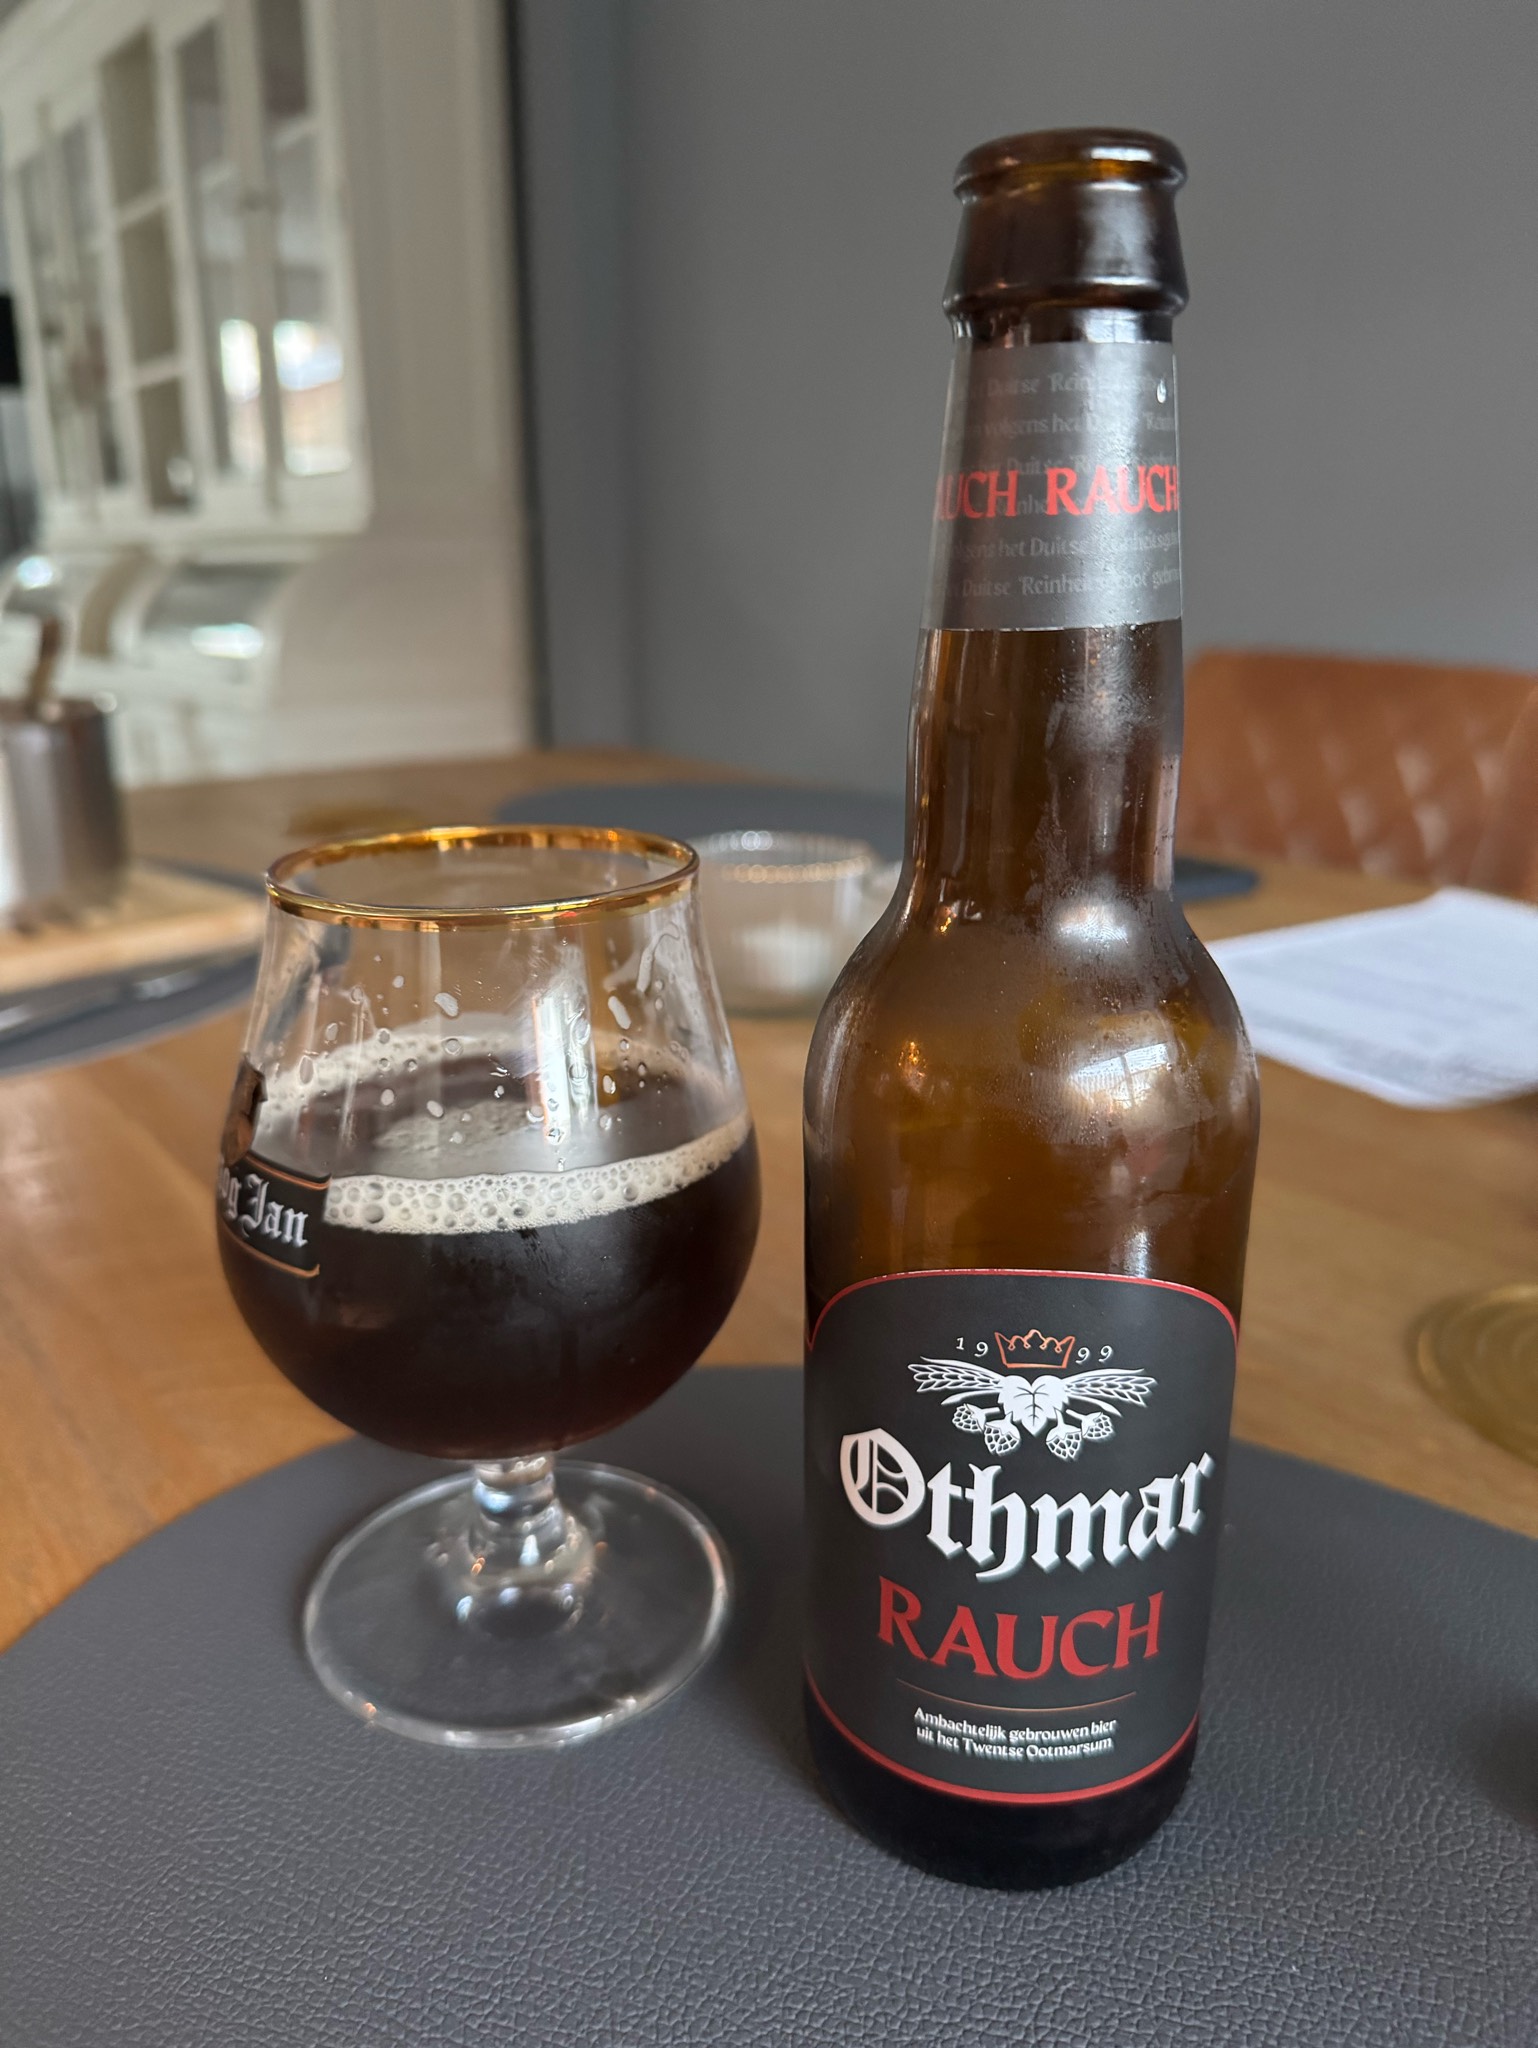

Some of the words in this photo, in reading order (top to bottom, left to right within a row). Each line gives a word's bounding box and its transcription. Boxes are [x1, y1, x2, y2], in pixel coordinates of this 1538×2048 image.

[938, 468, 1019, 520] UCH
[1046, 464, 1178, 517] RAUCH
[238, 1173, 309, 1248] Jan
[840, 1427, 1214, 1582] Othmar
[878, 1575, 1164, 1680] RAUCH
[914, 1706, 1006, 1741] Ambachtelijk
[1009, 1726, 1090, 1743] gebrouwen
[1090, 1719, 1117, 1736] bier
[916, 1726, 935, 1742] uit
[937, 1729, 960, 1749] het
[962, 1737, 1024, 1757] Twentse
[1026, 1737, 1113, 1758] Ootmarsum
